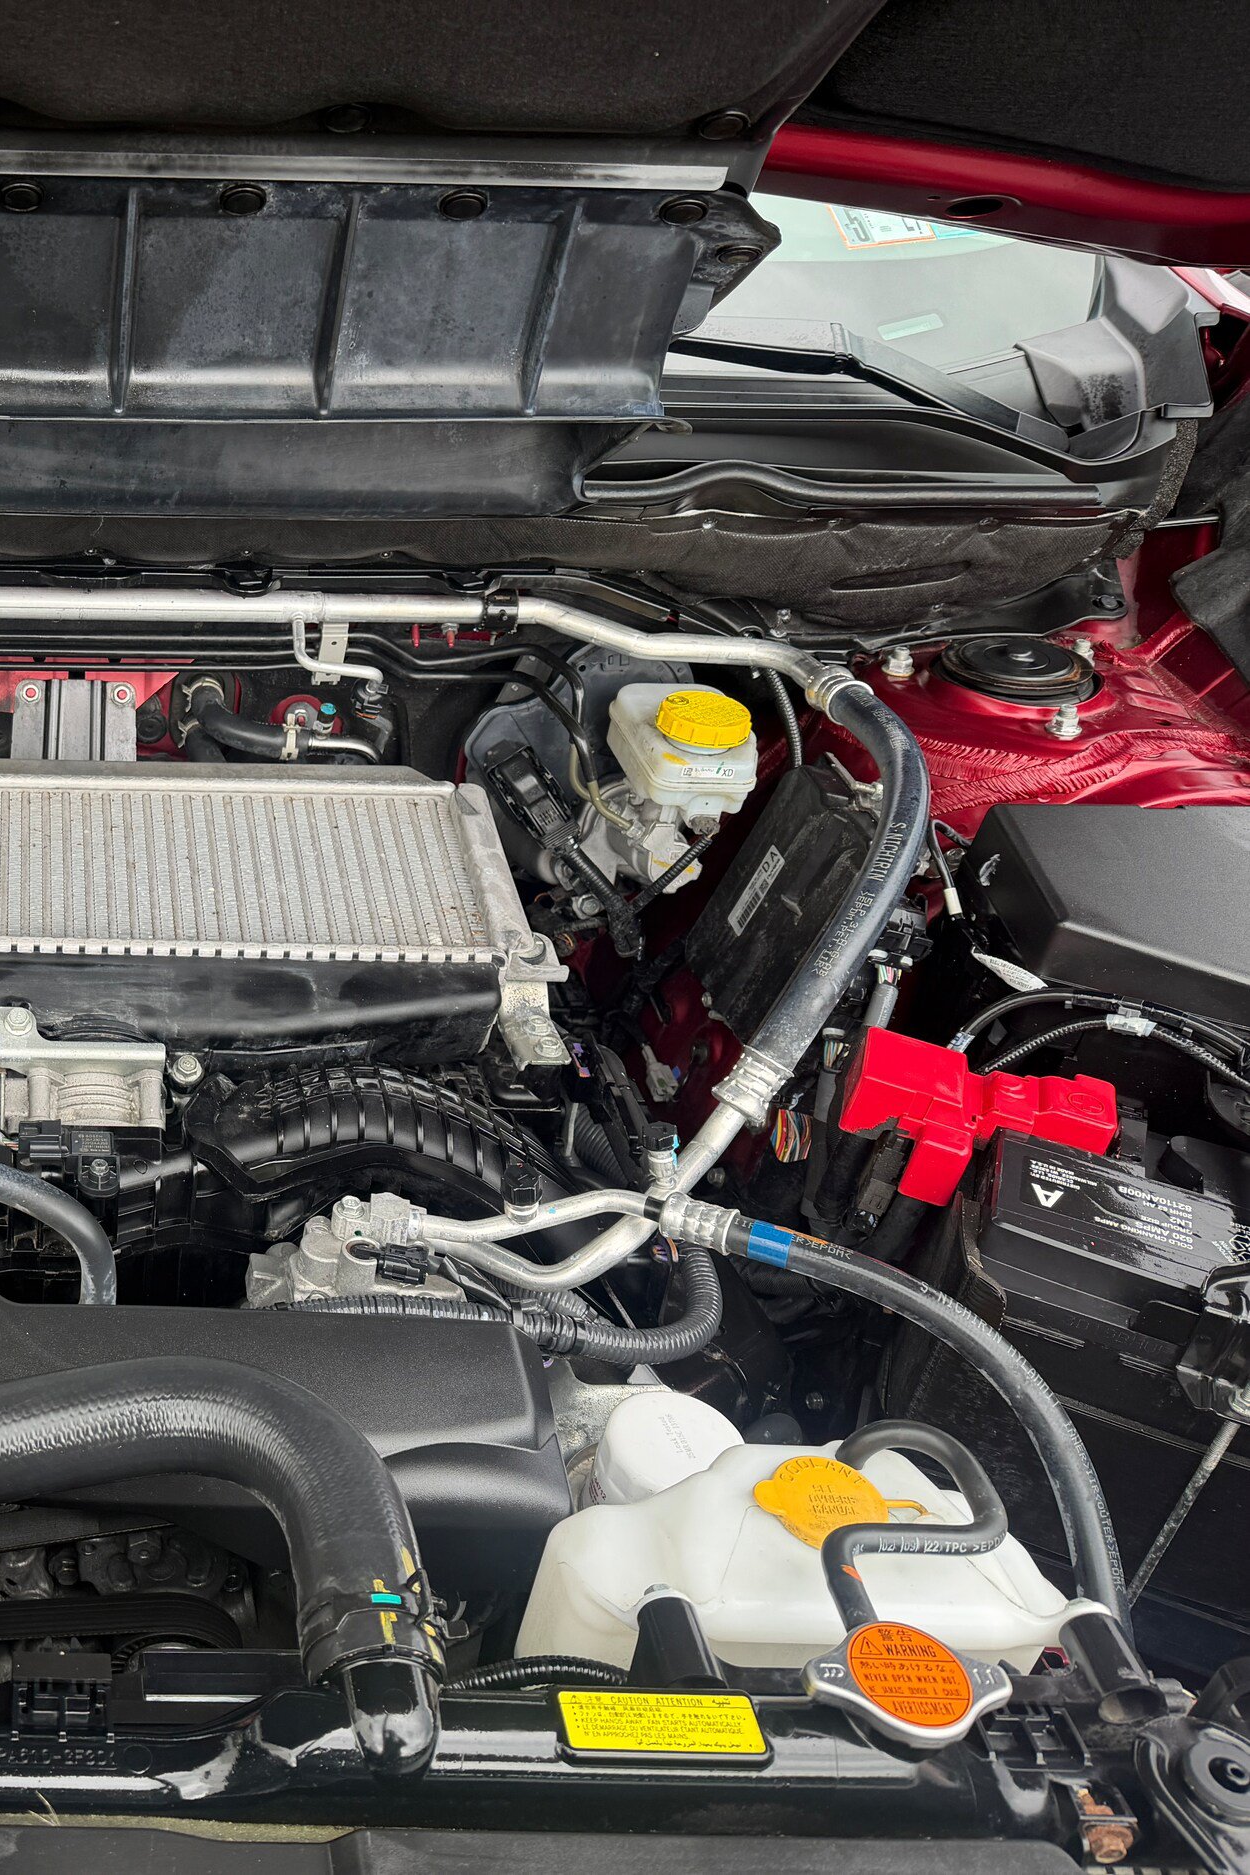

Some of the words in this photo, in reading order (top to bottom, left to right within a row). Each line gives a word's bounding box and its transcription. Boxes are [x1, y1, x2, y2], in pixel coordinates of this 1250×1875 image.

[721, 768, 734, 777] XD
[1031, 1183, 1064, 1208] A
[1118, 1185, 1193, 1212] 82110AN00B
[1093, 1216, 1119, 1228] AMPS
[1140, 1215, 1160, 1226] SIZE
[1161, 1219, 1193, 1235] GROUP
[1169, 1216, 1193, 1229] LN2
[1120, 1223, 1166, 1243] CRANKING
[1134, 1220, 1170, 1237] AMPS
[1172, 1231, 1193, 1243] 620
[1168, 1239, 1194, 1250] COLD
[779, 1458, 867, 1485] COOLANT
[945, 1542, 967, 1553] TPC
[878, 1628, 912, 1642] 警告
[882, 1644, 937, 1658] WARNING
[864, 1674, 888, 1682] NEVER
[894, 1675, 913, 1683] OPEN
[916, 1676, 938, 1684] WHEN
[611, 1696, 649, 1705] CAUTION
[656, 1697, 703, 1706] ATTENTION
